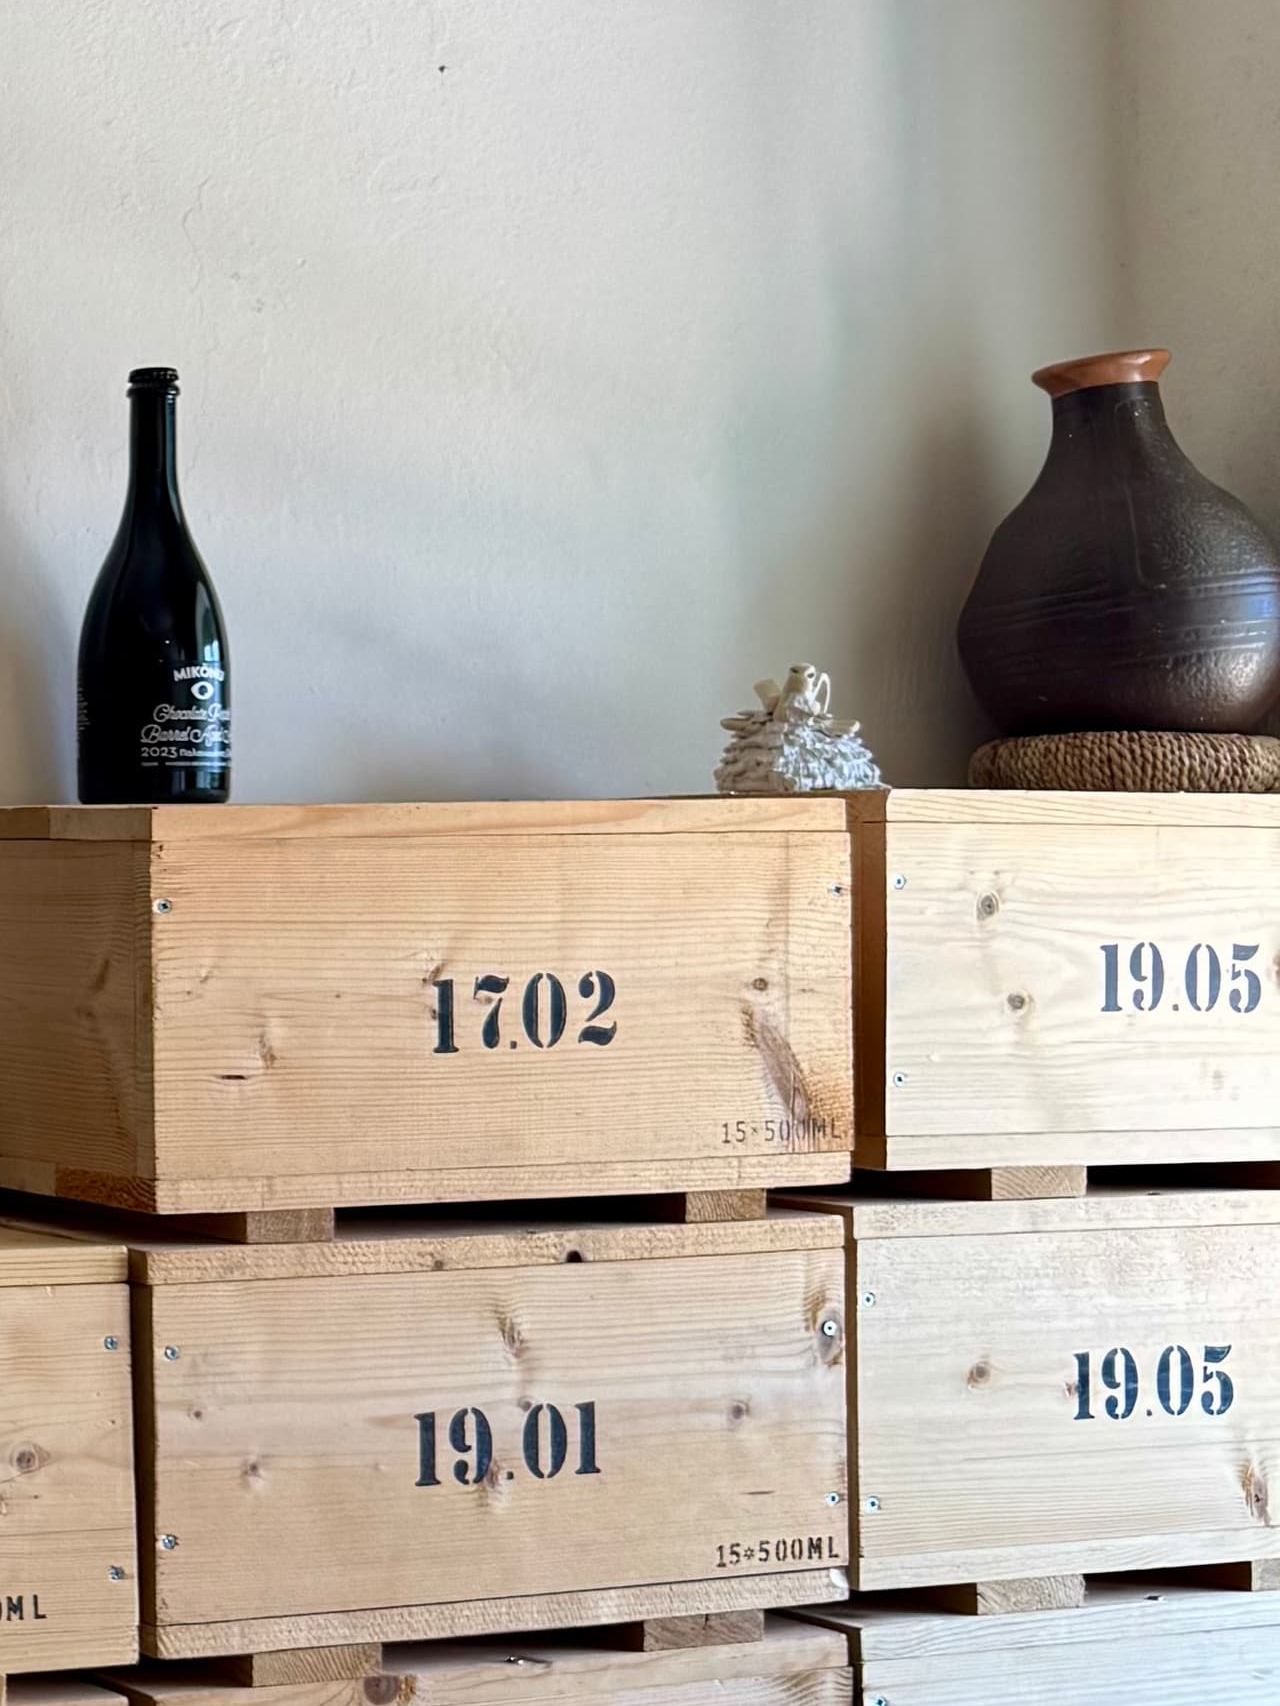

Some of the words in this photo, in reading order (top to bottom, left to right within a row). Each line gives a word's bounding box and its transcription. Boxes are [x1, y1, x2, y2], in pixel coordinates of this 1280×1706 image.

[141, 747, 177, 758] 2023
[431, 969, 617, 1053] 17.02
[1100, 942, 1261, 1013] 19.05
[1073, 1344, 1234, 1421] 19.05
[414, 1401, 601, 1487] 19.01
